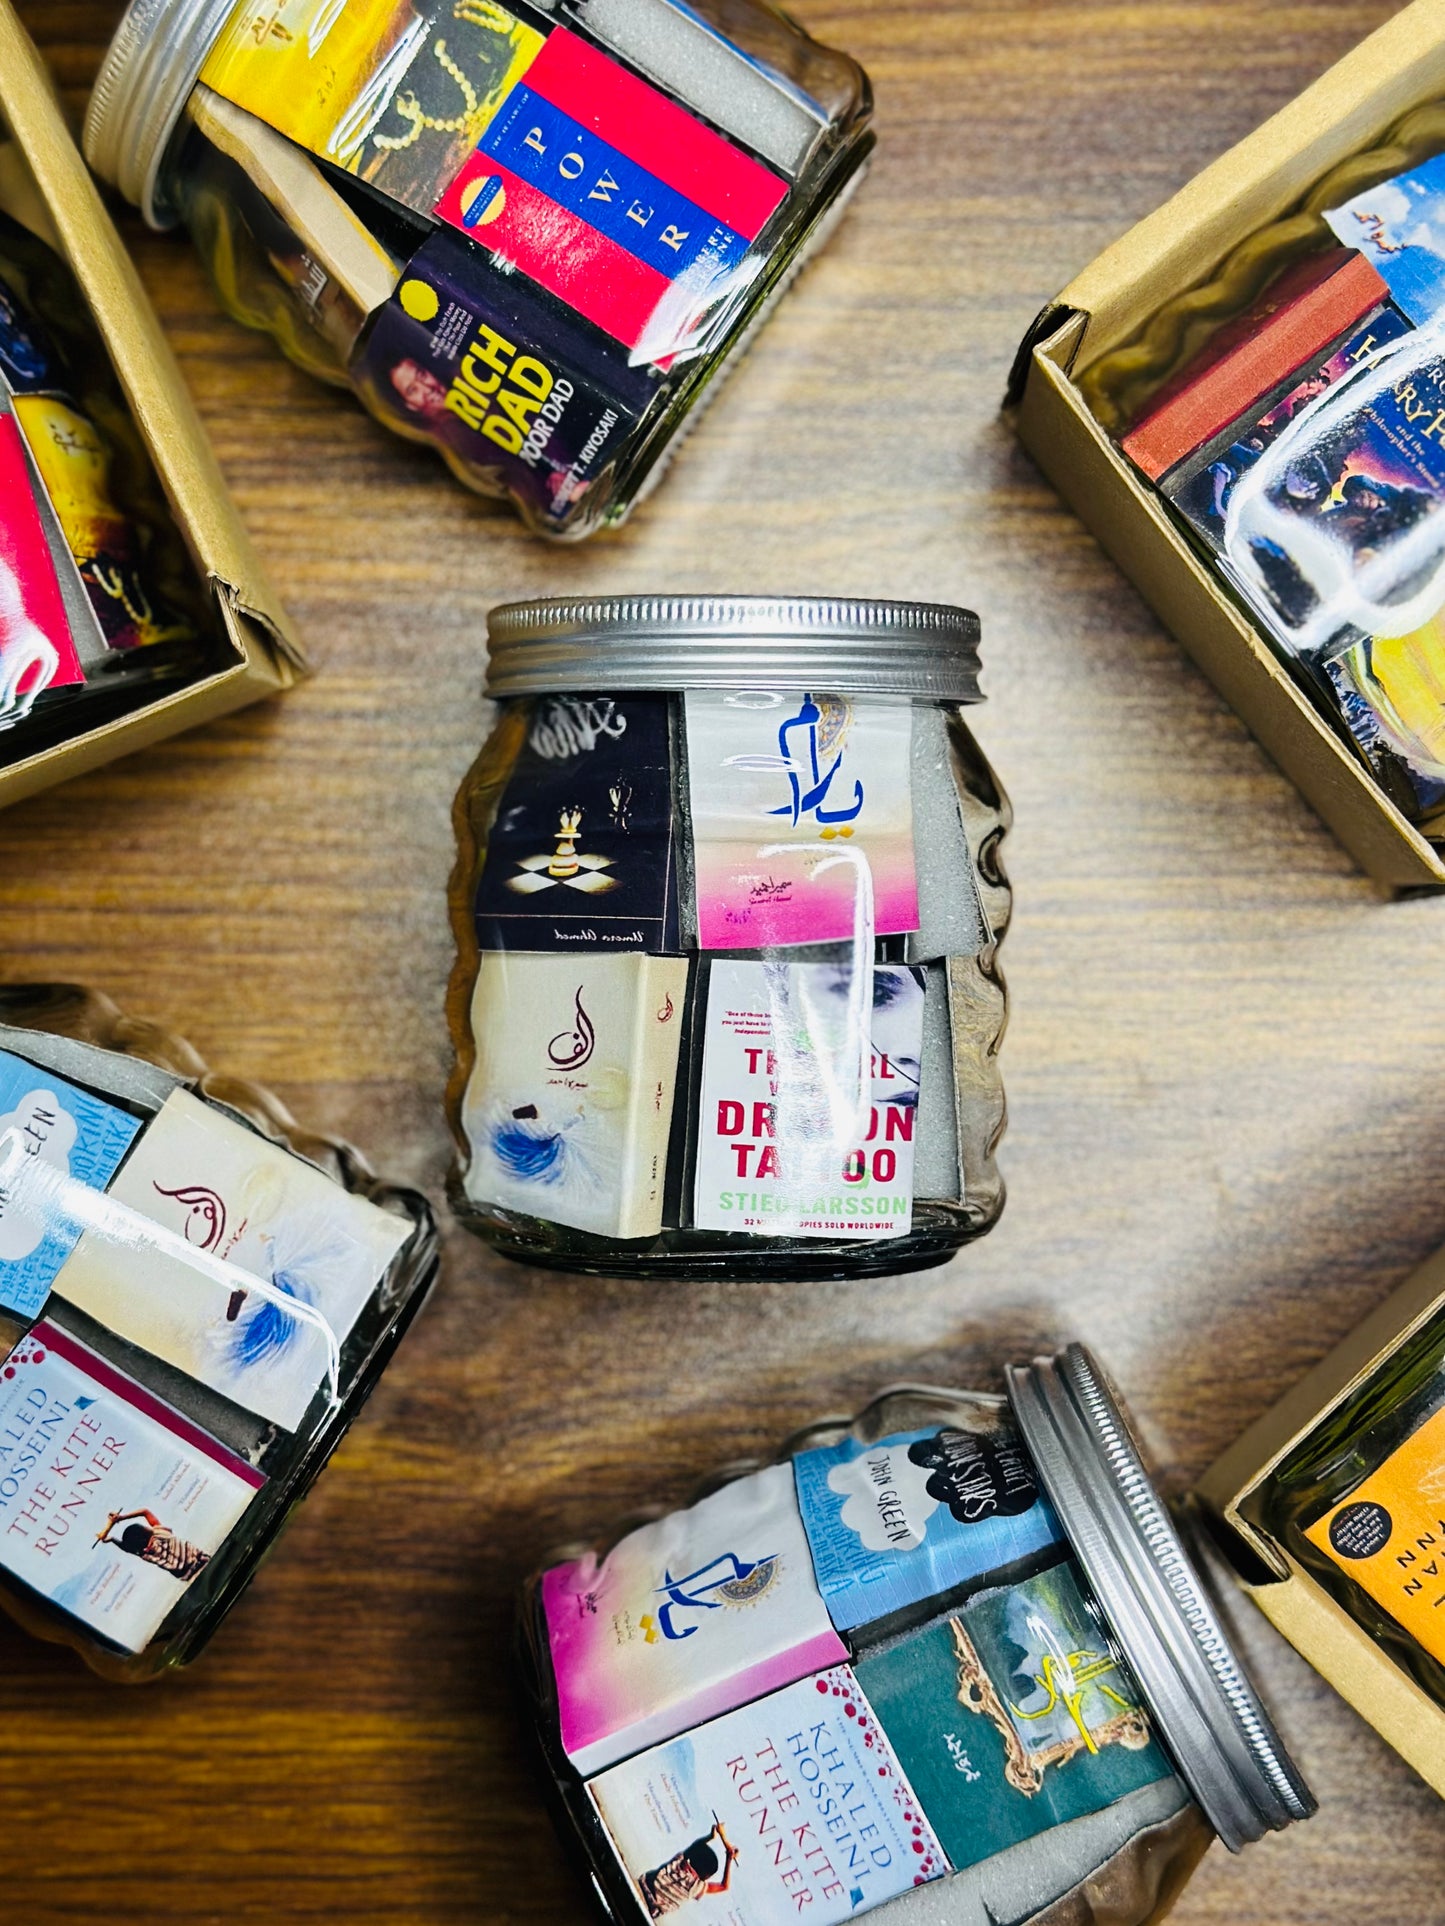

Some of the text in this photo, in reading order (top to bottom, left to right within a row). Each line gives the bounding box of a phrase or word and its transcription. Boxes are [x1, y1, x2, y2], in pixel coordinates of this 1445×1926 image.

[521, 123, 689, 252] POWER
[442, 323, 517, 430] RICH
[479, 351, 559, 454] DAD
[539, 377, 576, 423] DAD
[571, 460, 587, 475] T.
[578, 408, 619, 464] KIYOSAKI
[1396, 425, 1426, 456] and the
[730, 1143, 897, 1183] TAOO
[824, 1221, 846, 1229] SOLD
[847, 1221, 894, 1230] WORLDWIDE
[0, 1399, 71, 1507] OSSEINI
[6, 1412, 102, 1537] THE KITE
[33, 1432, 128, 1557] RUNNER
[867, 1454, 911, 1542] JOHN GREEN
[949, 1461, 996, 1517] STARS
[812, 1540, 852, 1596] ALASKA
[725, 1755, 814, 1914] RUNNER
[755, 1737, 845, 1901] THE KITE
[785, 1731, 871, 1880] HOSSEINI
[808, 1721, 890, 1870] KHALED
